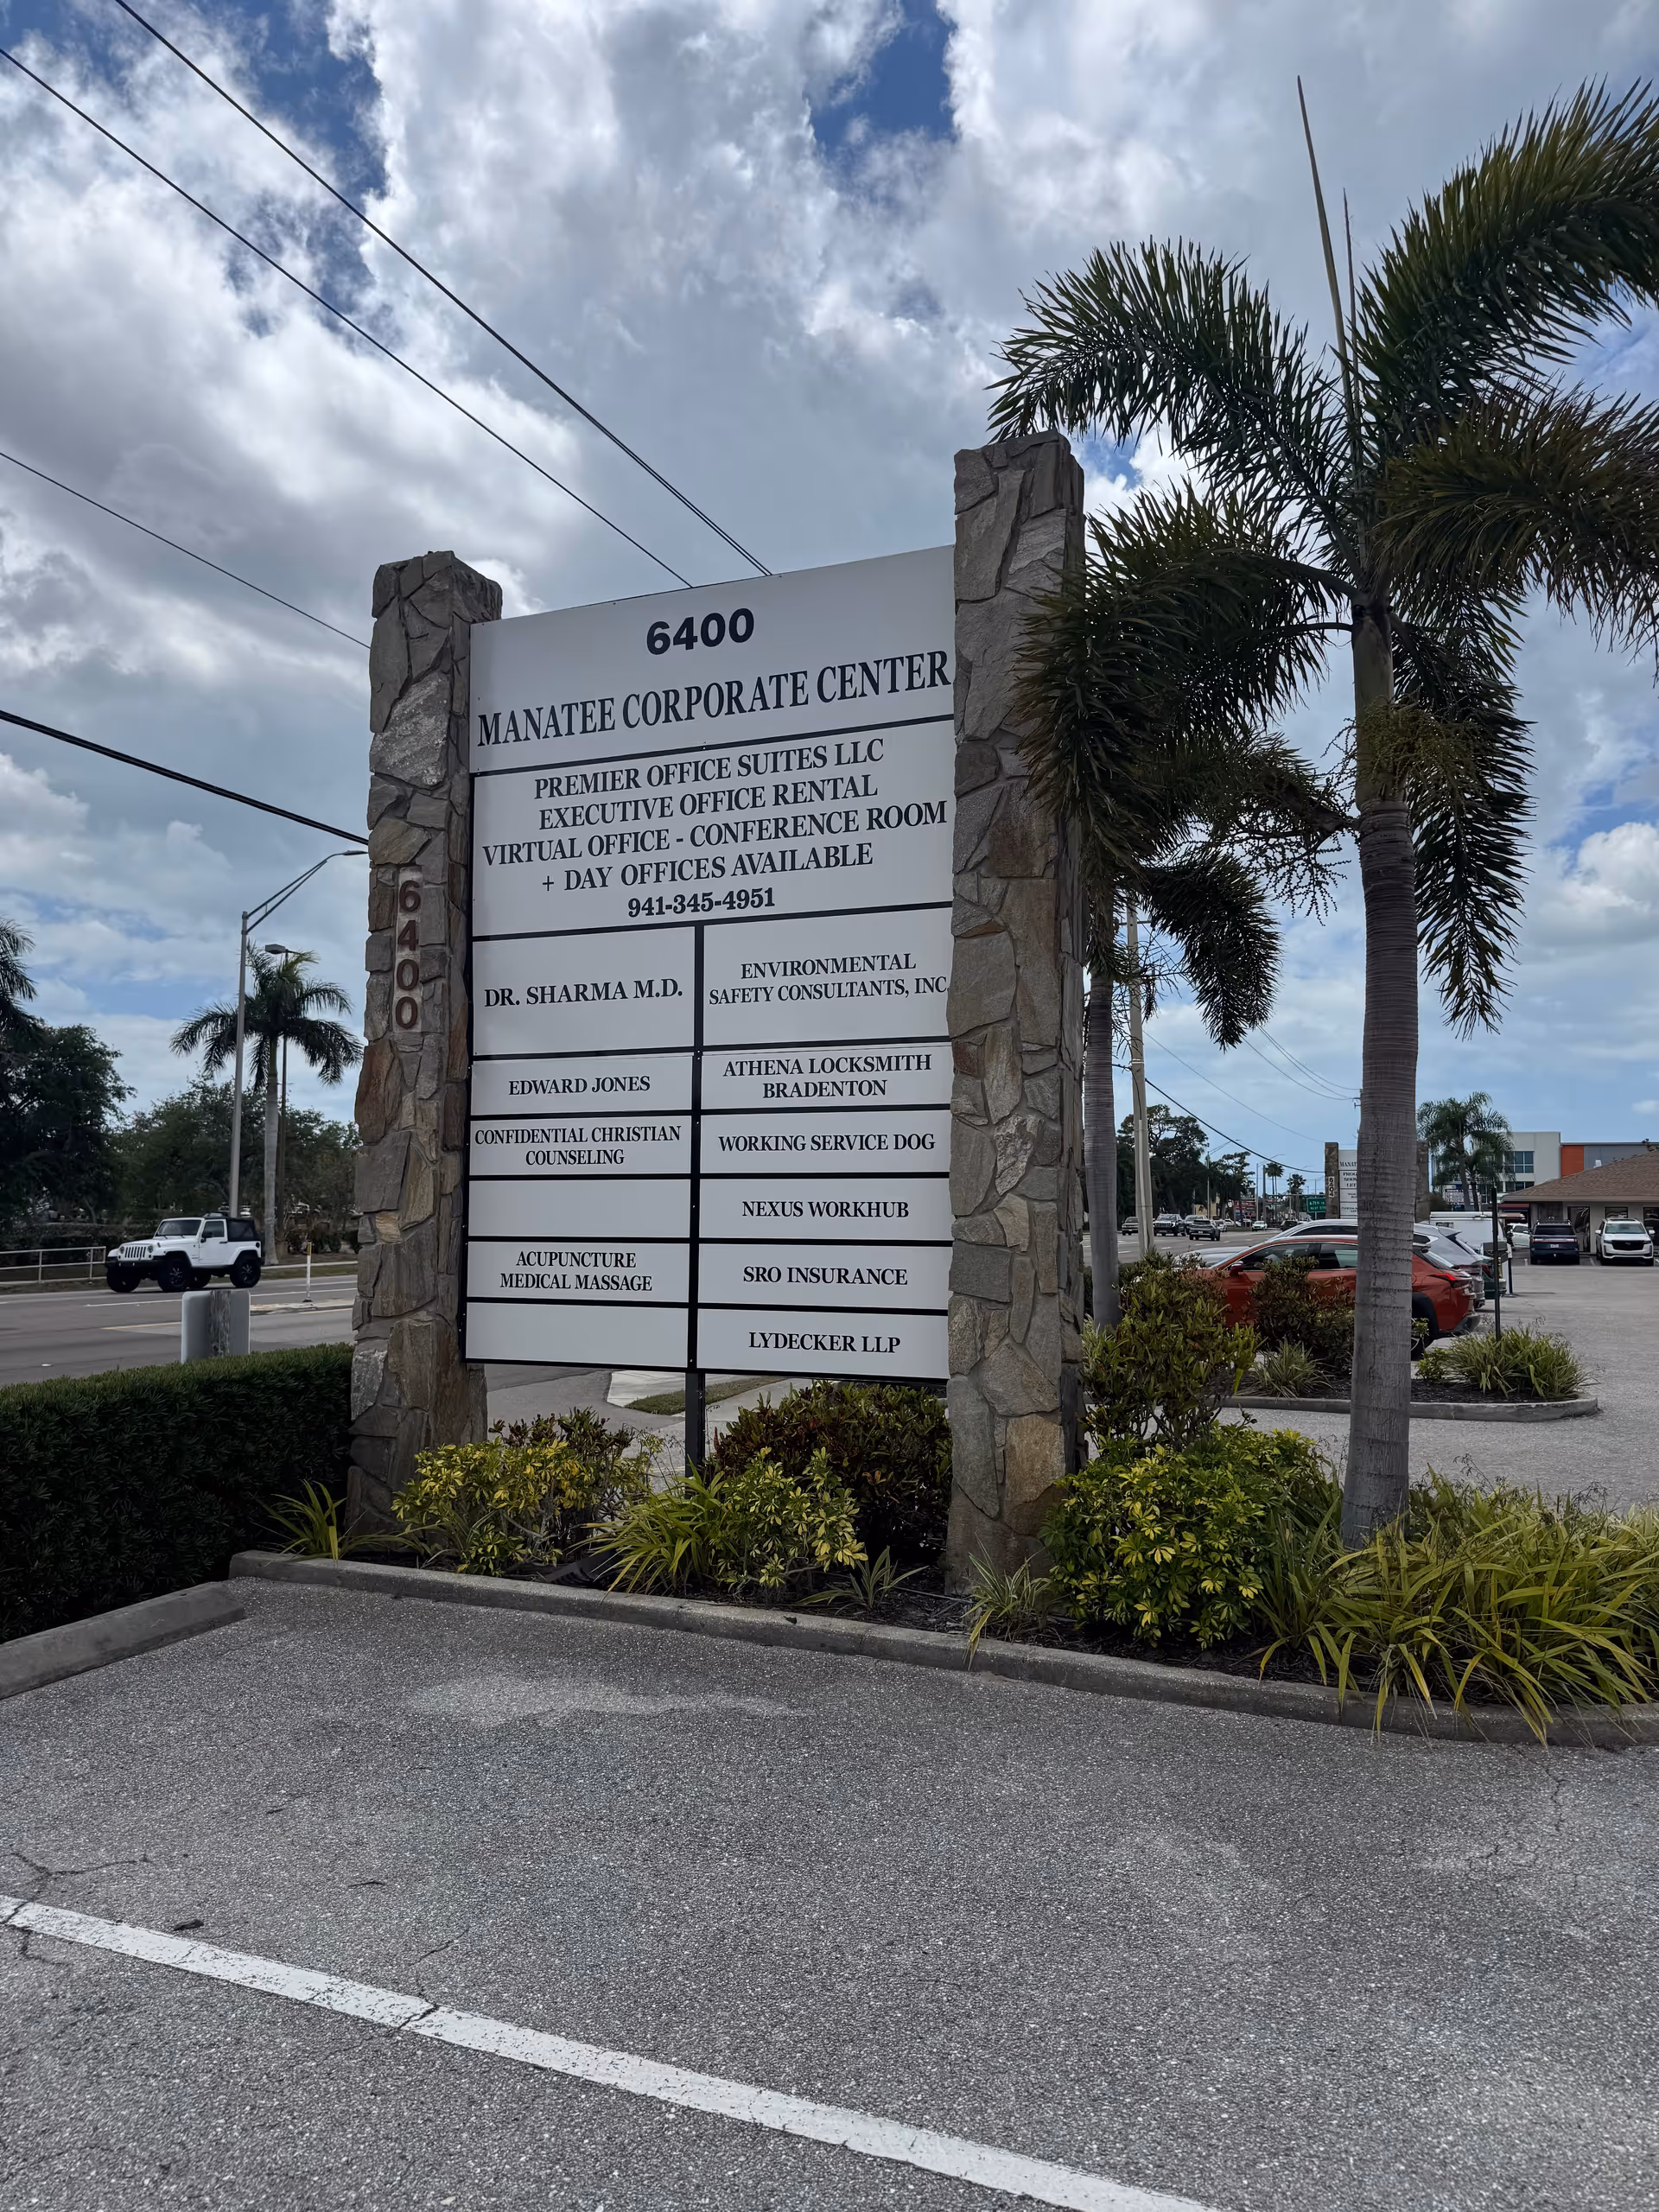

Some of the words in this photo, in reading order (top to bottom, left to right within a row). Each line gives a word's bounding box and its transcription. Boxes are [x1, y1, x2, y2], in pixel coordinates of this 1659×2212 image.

[646, 607, 755, 656] 6400
[477, 697, 616, 747] MANATEE
[622, 671, 809, 729] CORPORATE
[816, 650, 952, 704] CENTER
[534, 767, 642, 800] PREMIER
[646, 757, 732, 787] OFFICE
[737, 746, 828, 777] SUITES
[834, 738, 884, 767] LLC
[538, 796, 674, 830] EXECUTIVE
[679, 787, 766, 817] OFFICE
[772, 773, 879, 807] RENTAL
[481, 834, 582, 866] VIRTUAL
[588, 828, 671, 856] OFFICE
[690, 810, 860, 848] CONFERENCE
[866, 800, 948, 831] ROOM
[542, 875, 555, 892] +
[563, 866, 613, 891] DAY
[620, 855, 726, 887] OFFICES
[730, 842, 874, 876] AVAILABLE
[627, 887, 775, 918] 941-345-4951
[395, 880, 422, 1030] 6400
[741, 953, 917, 980] ENVIRONMENTAL
[484, 988, 520, 1007] DR.
[526, 982, 629, 1005] SHARMA
[632, 978, 683, 999] M.D.
[709, 986, 774, 1006] SAFETY
[778, 978, 910, 1001] CONSULTANTS,
[722, 1058, 804, 1077] ATHENA
[808, 1053, 931, 1075] LOCKSMITH
[508, 1077, 588, 1096] EDWARD
[591, 1075, 652, 1094] JONES
[762, 1079, 887, 1099] BRADENTON
[474, 1128, 588, 1146] CONFIDENTIAL
[591, 1125, 682, 1143] CHRISTIAN
[718, 1135, 807, 1153] WORKING
[810, 1134, 889, 1152] SERVICE
[893, 1133, 936, 1151] DOG
[525, 1148, 626, 1166] COUNSELING
[741, 1200, 804, 1218] NEXUS
[807, 1200, 909, 1219] WORKHUB
[515, 1250, 637, 1268] ACUPUNCTURE
[499, 1273, 572, 1290] MEDICAL
[575, 1274, 652, 1293] MASSAGE
[743, 1266, 782, 1284] SRO
[786, 1267, 908, 1287] INSURANCE
[748, 1332, 857, 1353] LYDECKER
[861, 1335, 901, 1355] LLP
